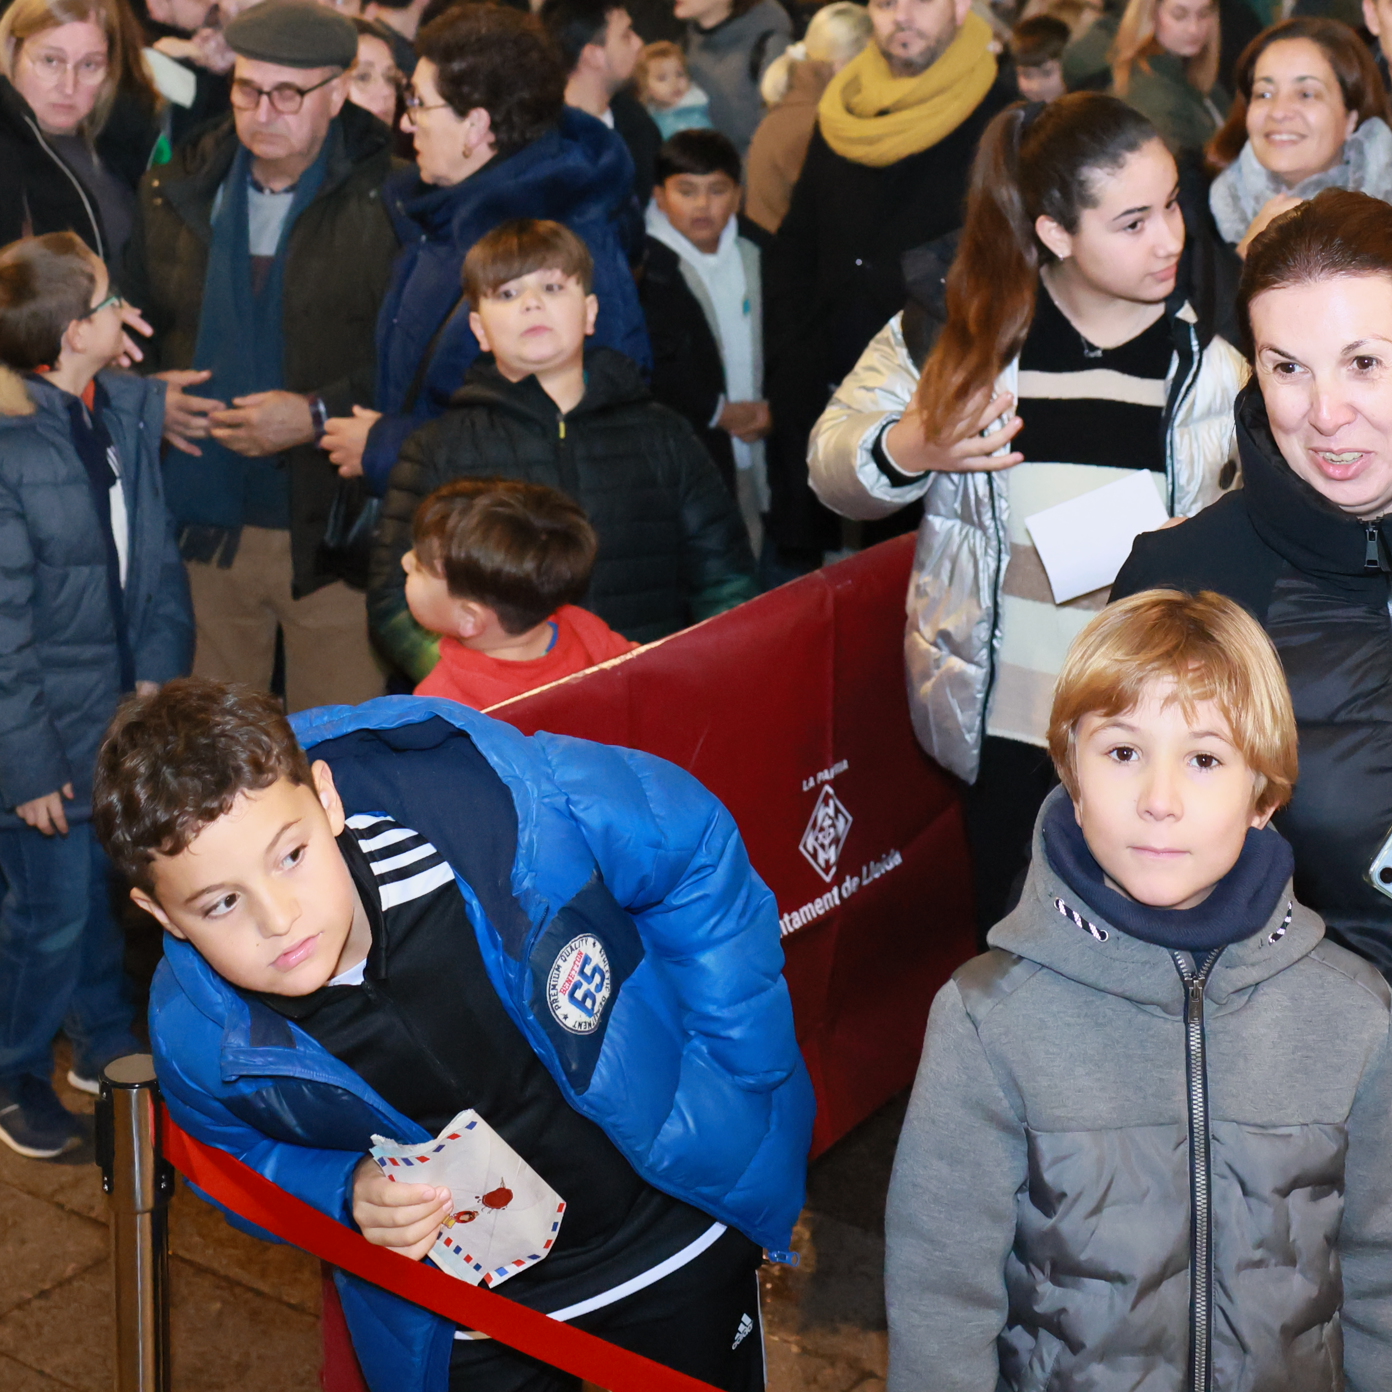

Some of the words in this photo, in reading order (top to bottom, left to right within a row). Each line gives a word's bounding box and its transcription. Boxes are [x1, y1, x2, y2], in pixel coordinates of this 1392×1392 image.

[802, 776, 815, 792] LA
[841, 875, 860, 899] de
[549, 964, 563, 1012] PREMIUM
[561, 937, 589, 963] QUALITY
[559, 950, 584, 996] BENETTON
[567, 953, 606, 1019] 65
[731, 1320, 754, 1350] adida
